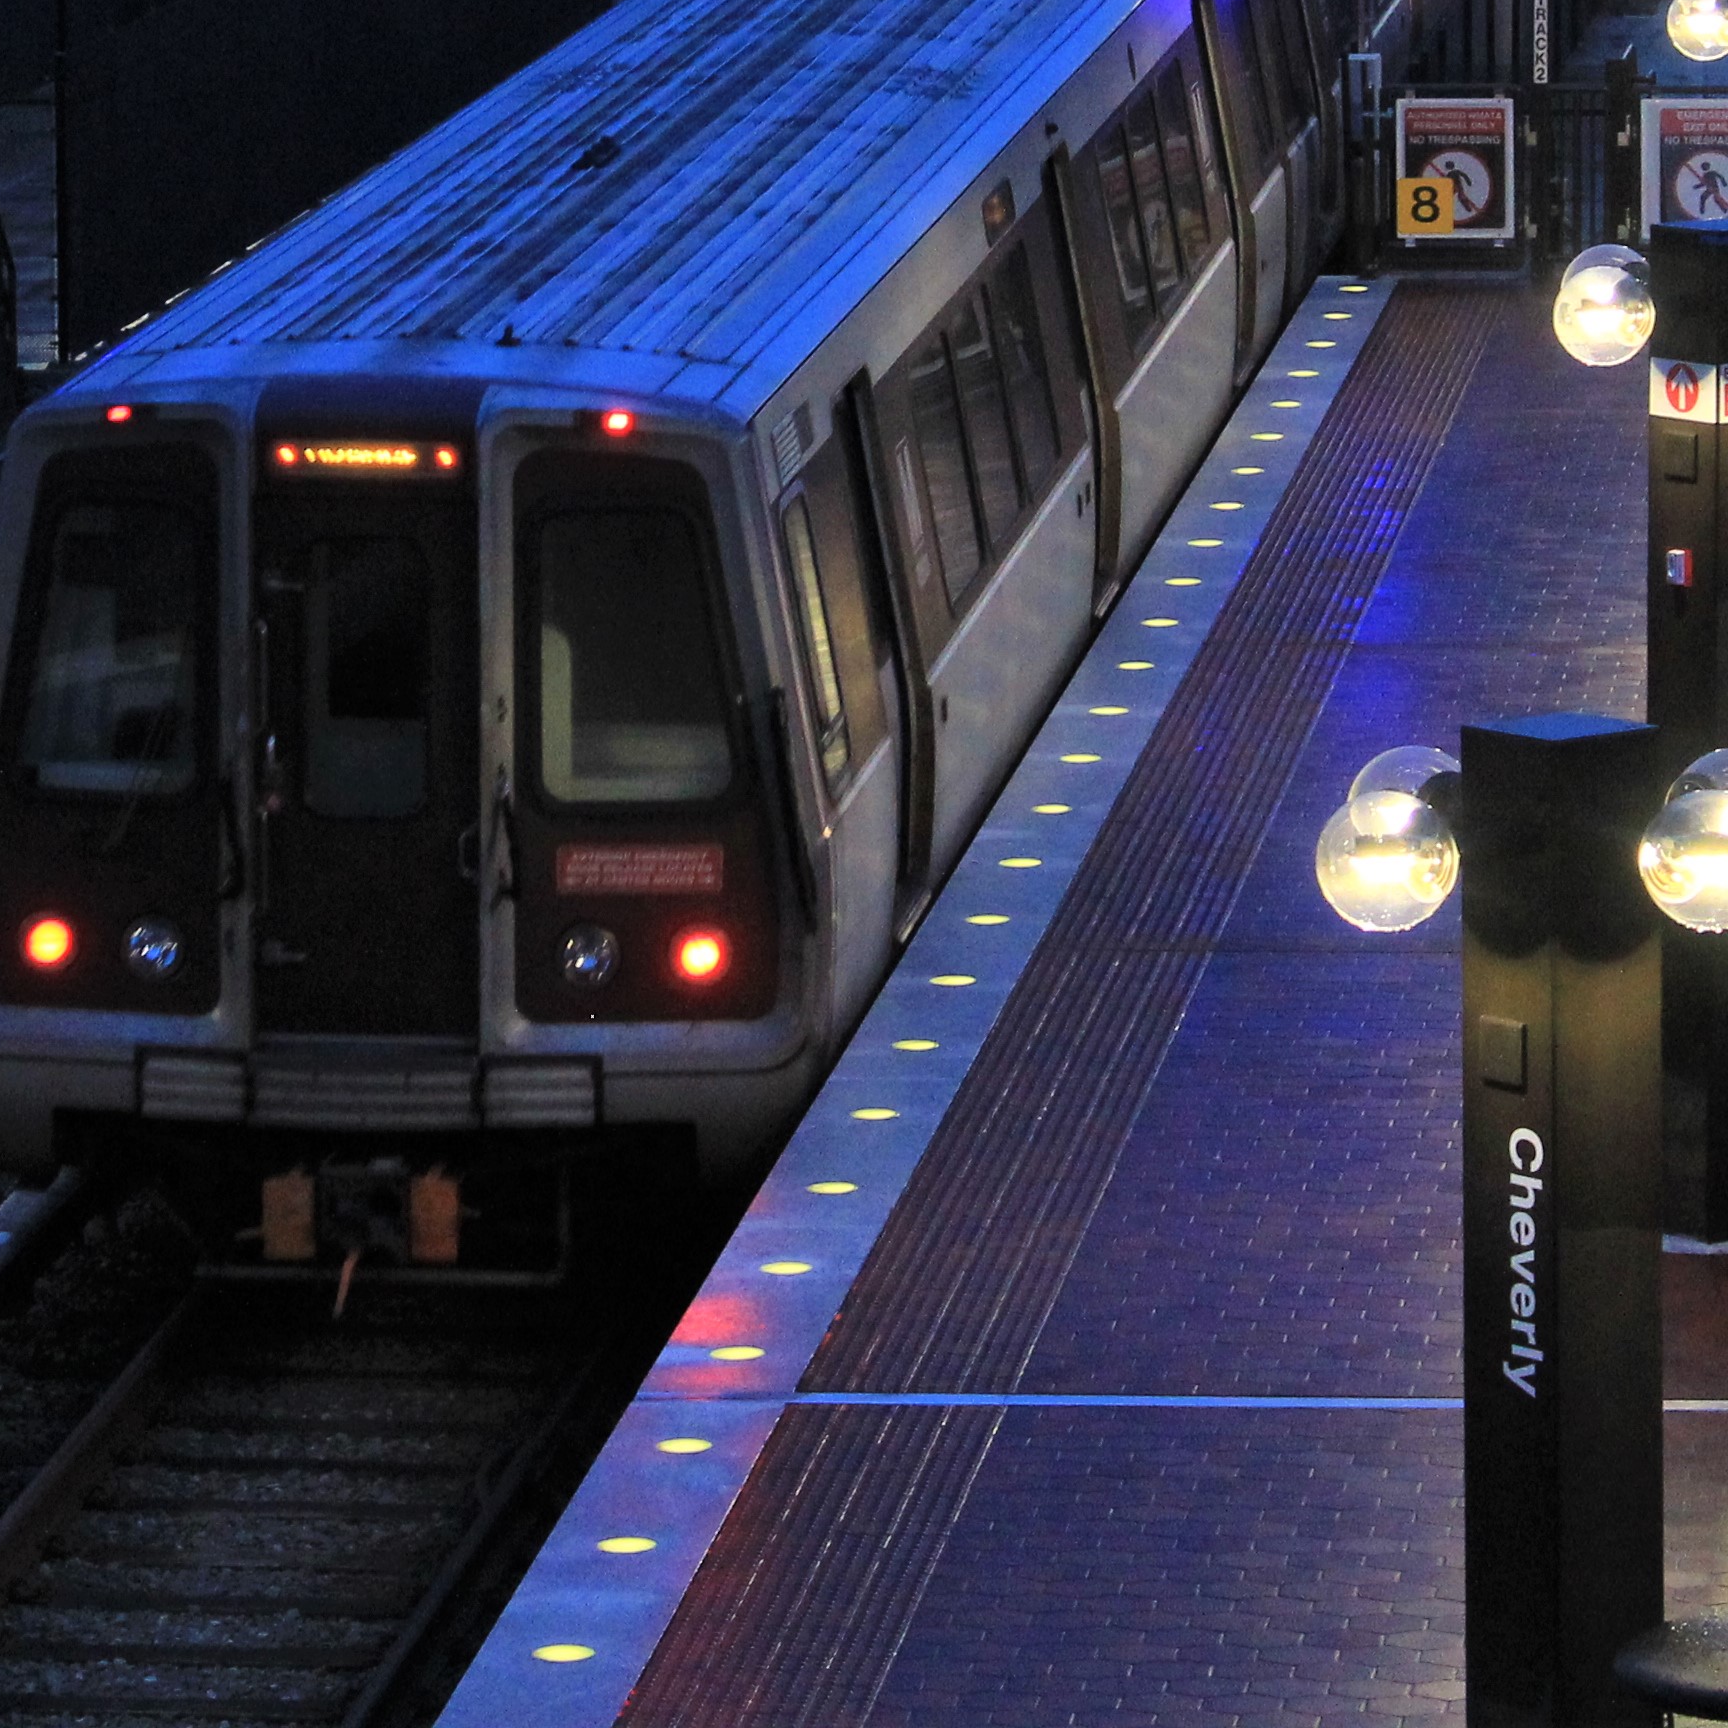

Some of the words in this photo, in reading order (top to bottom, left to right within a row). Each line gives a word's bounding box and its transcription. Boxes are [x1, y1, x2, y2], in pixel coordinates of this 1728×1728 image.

[1471, 121, 1496, 129] ONLY
[1409, 135, 1425, 144] NO
[1427, 135, 1502, 144] TRESPASSING
[1664, 136, 1680, 145] NO
[1411, 185, 1440, 223] 8
[1502, 1126, 1545, 1399] Cheverly
